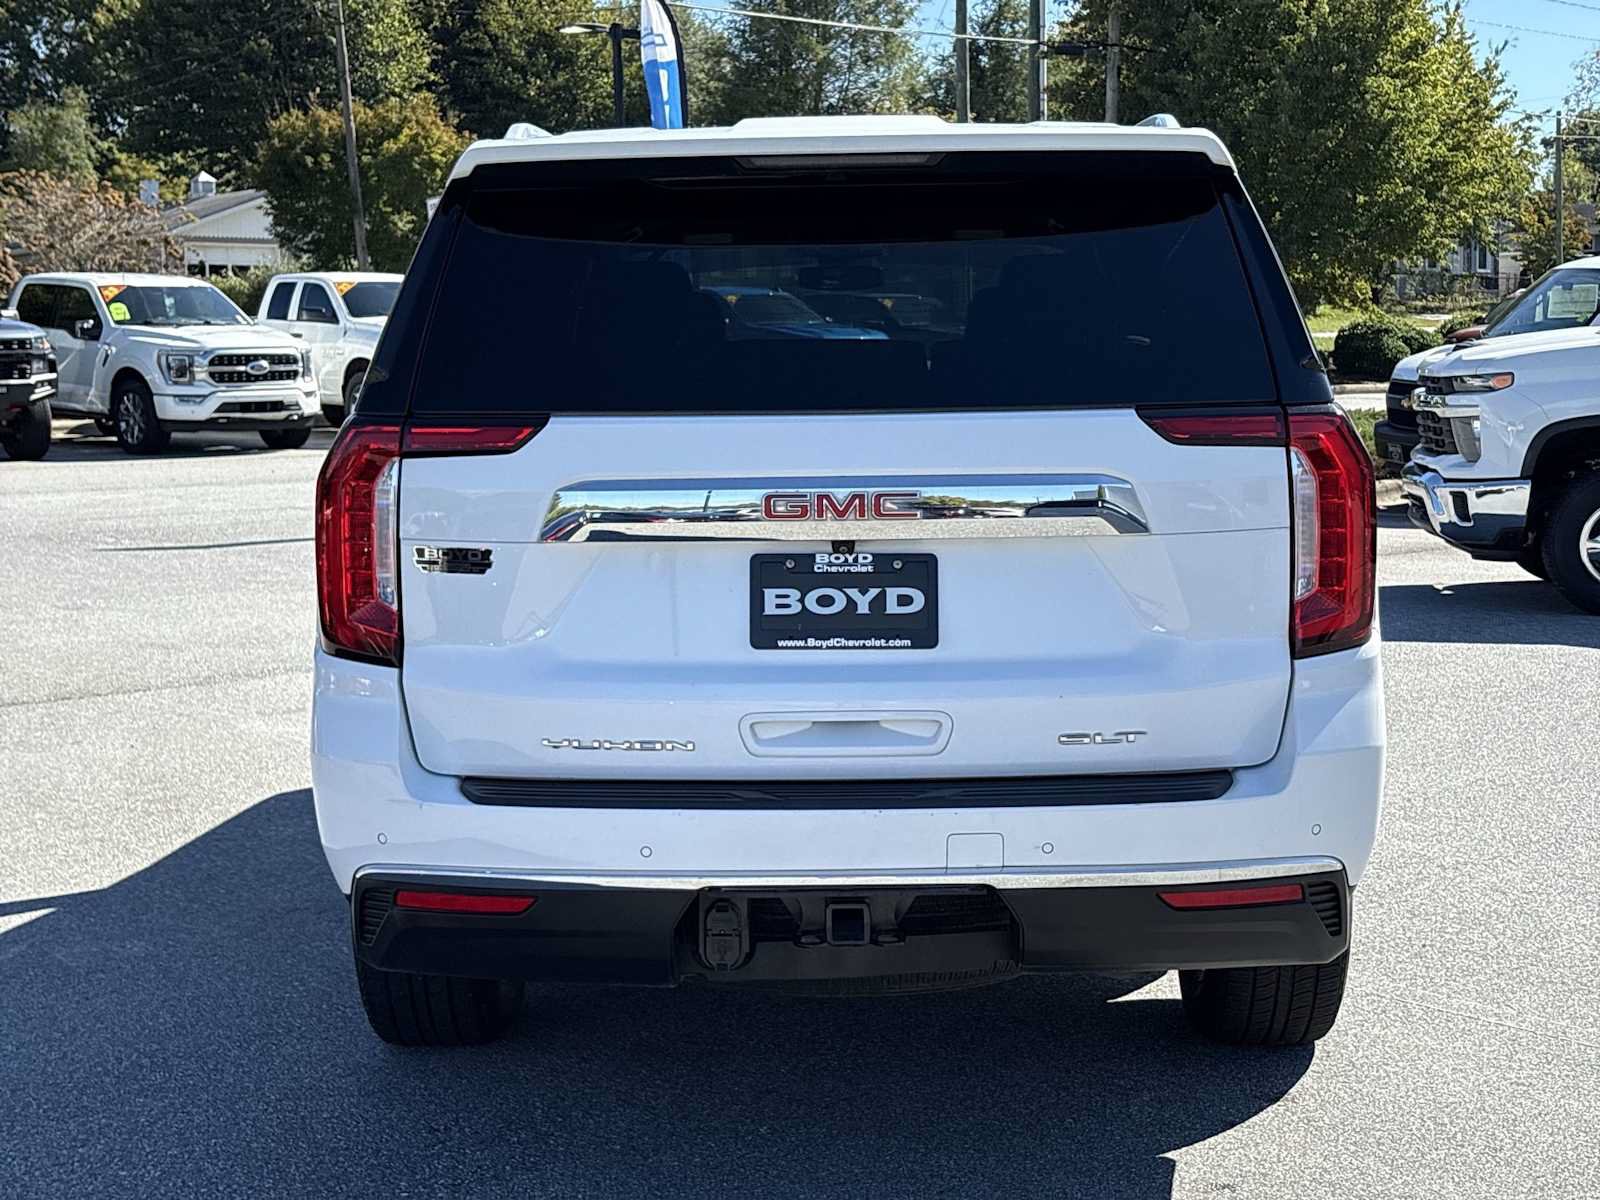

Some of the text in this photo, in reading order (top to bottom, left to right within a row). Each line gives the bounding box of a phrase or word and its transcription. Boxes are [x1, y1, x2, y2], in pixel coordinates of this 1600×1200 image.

[762, 491, 922, 521] GMC
[815, 553, 873, 564] BOYD
[813, 564, 874, 573] Chevrolet
[762, 587, 926, 615] BOYD
[777, 637, 911, 648] www.BoydChevrolet.com
[541, 738, 695, 751] YUKON
[1057, 731, 1147, 746] SLT
